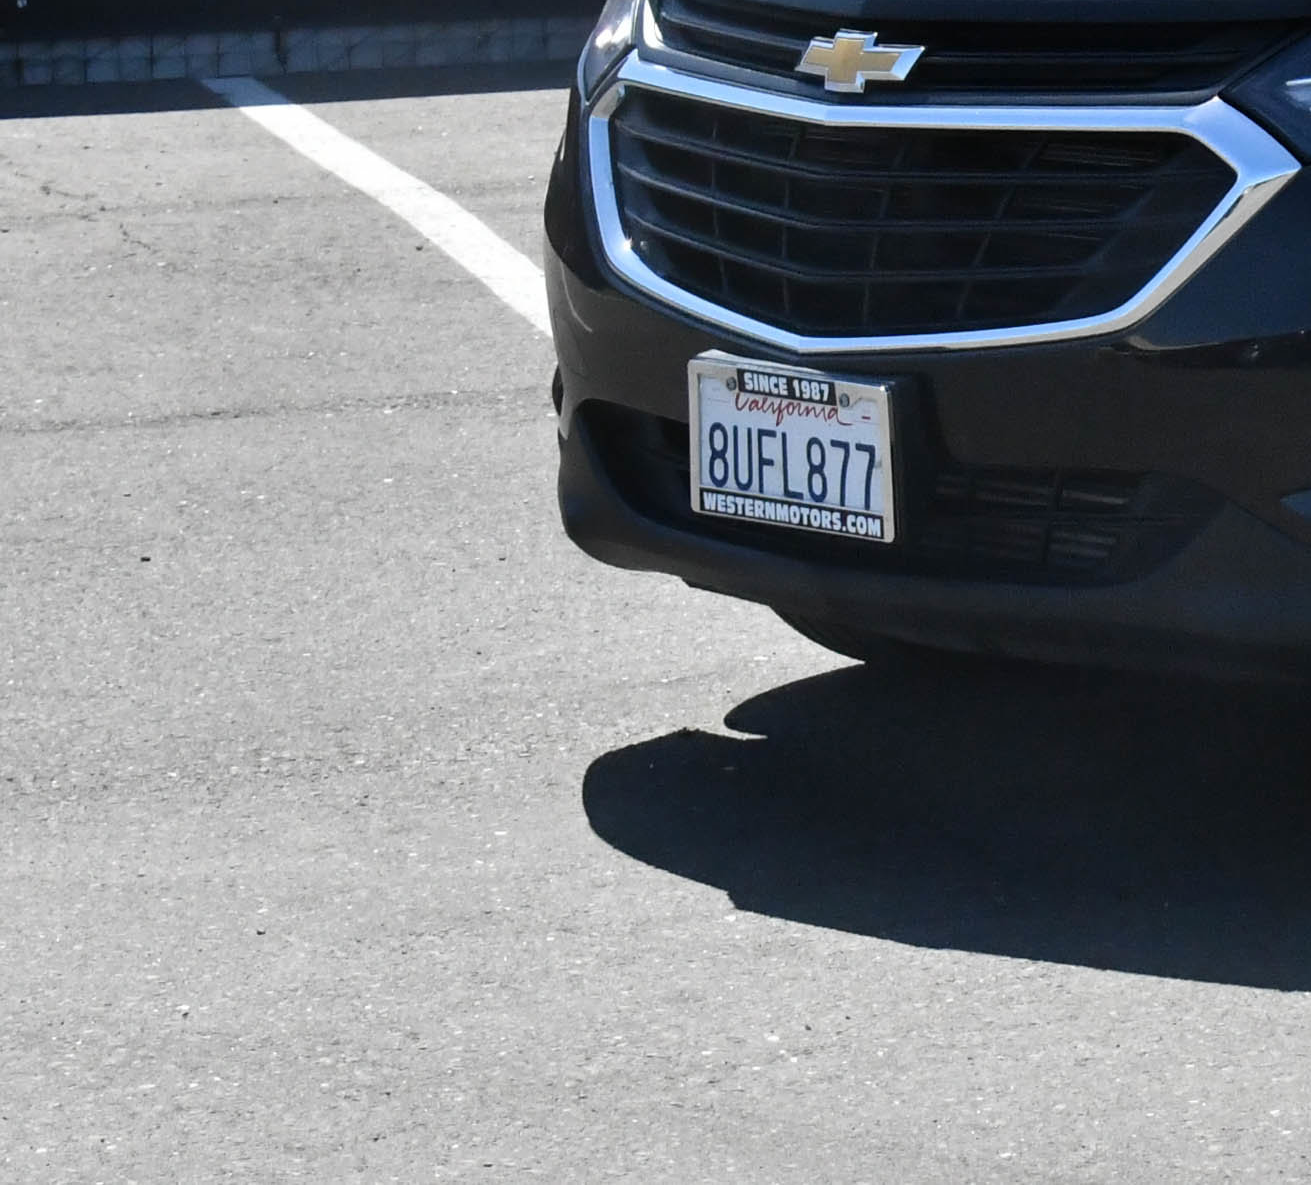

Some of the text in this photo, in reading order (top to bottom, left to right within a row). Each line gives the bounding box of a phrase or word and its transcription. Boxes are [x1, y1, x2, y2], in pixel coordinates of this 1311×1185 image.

[743, 371, 830, 402] SINCE 1987
[708, 421, 877, 512] 8UFL877
[703, 491, 882, 538] WESTERNMOTORS.COM
